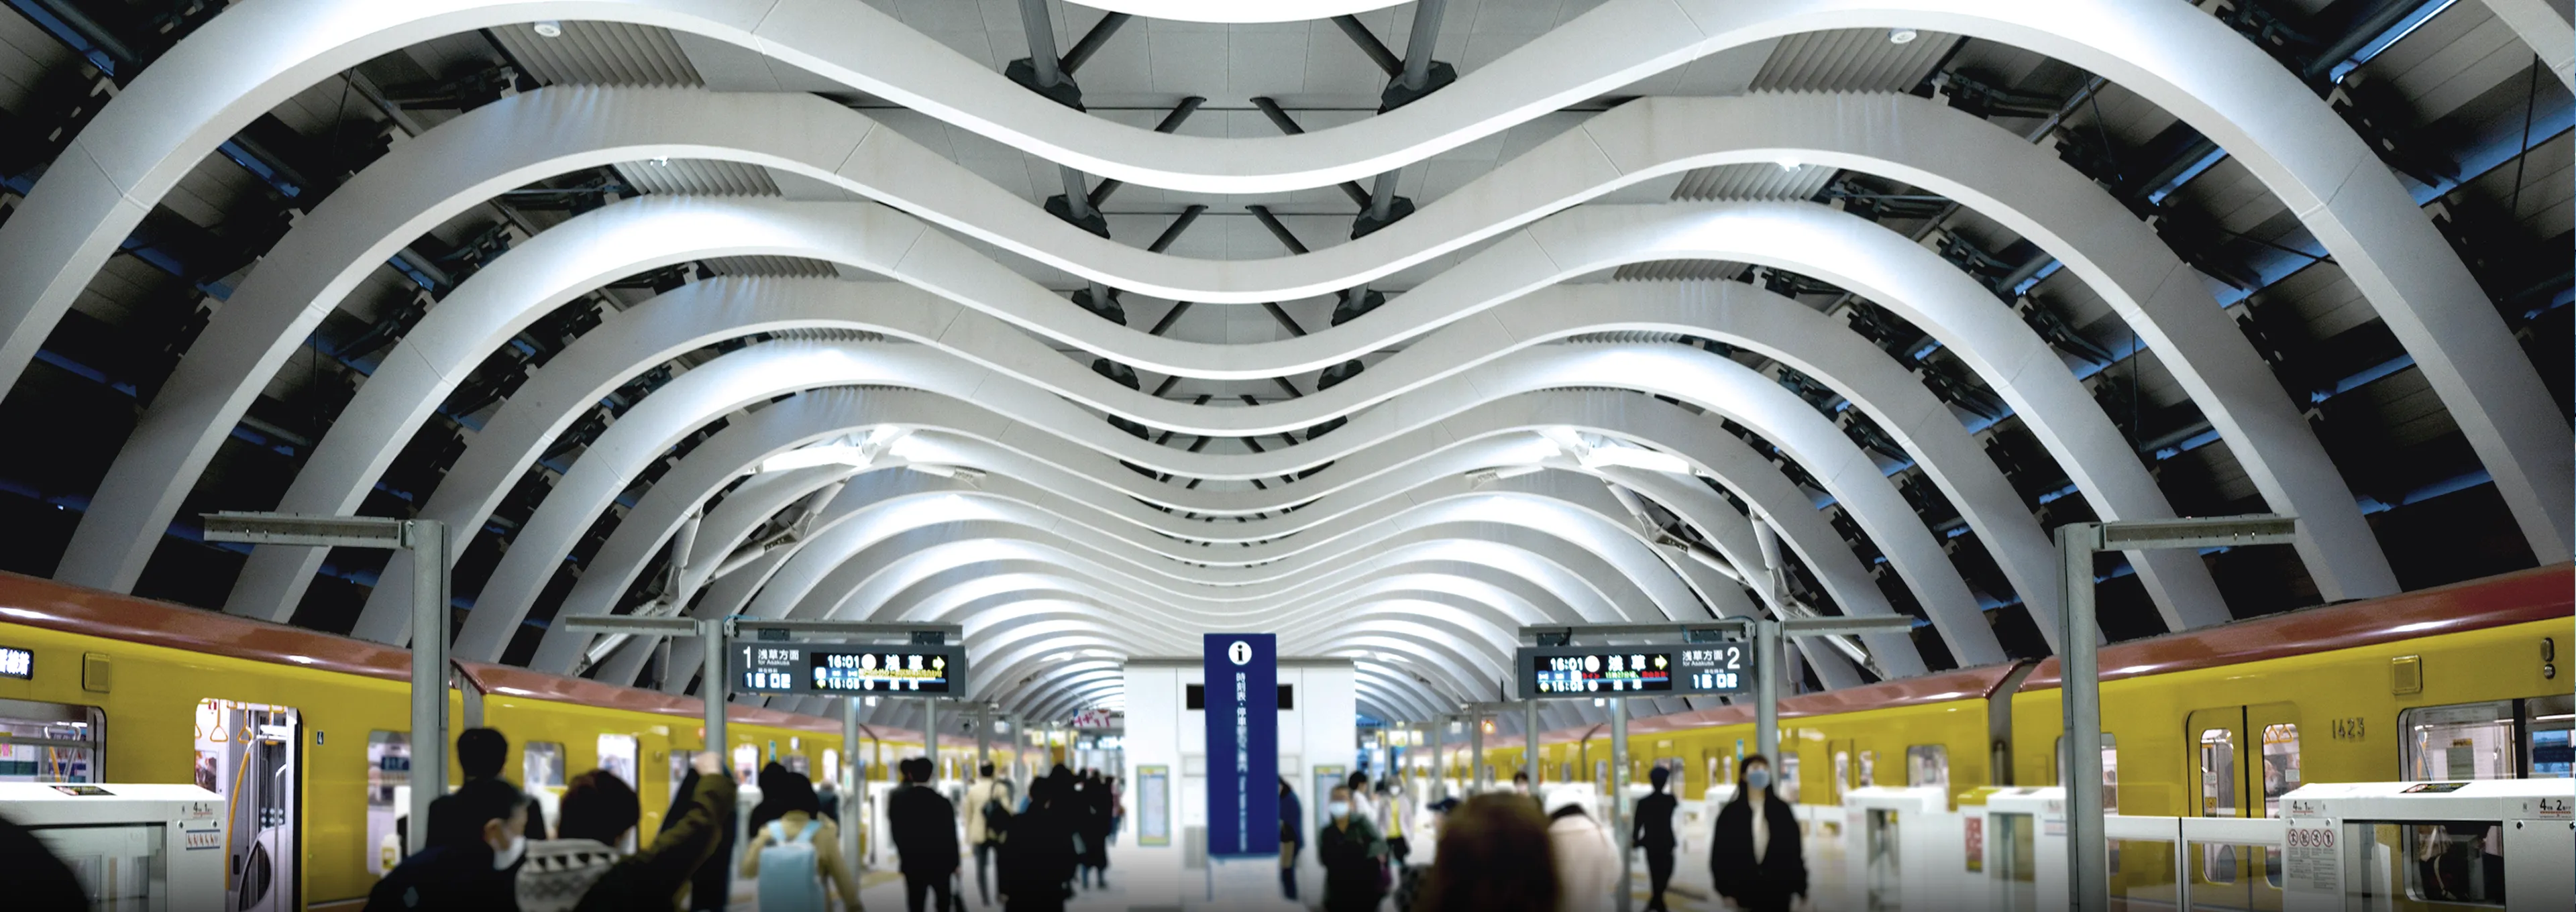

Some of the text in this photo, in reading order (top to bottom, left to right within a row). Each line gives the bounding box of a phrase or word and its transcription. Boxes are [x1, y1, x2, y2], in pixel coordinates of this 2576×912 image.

[743, 646, 751, 669] 1
[757, 648, 799, 661] 浅草方面
[828, 654, 859, 668] 16:01
[1682, 649, 1723, 661] 浅草方面
[1727, 646, 1740, 669] 2
[1550, 657, 1583, 671] 16:01
[2332, 717, 2365, 739] 1423
